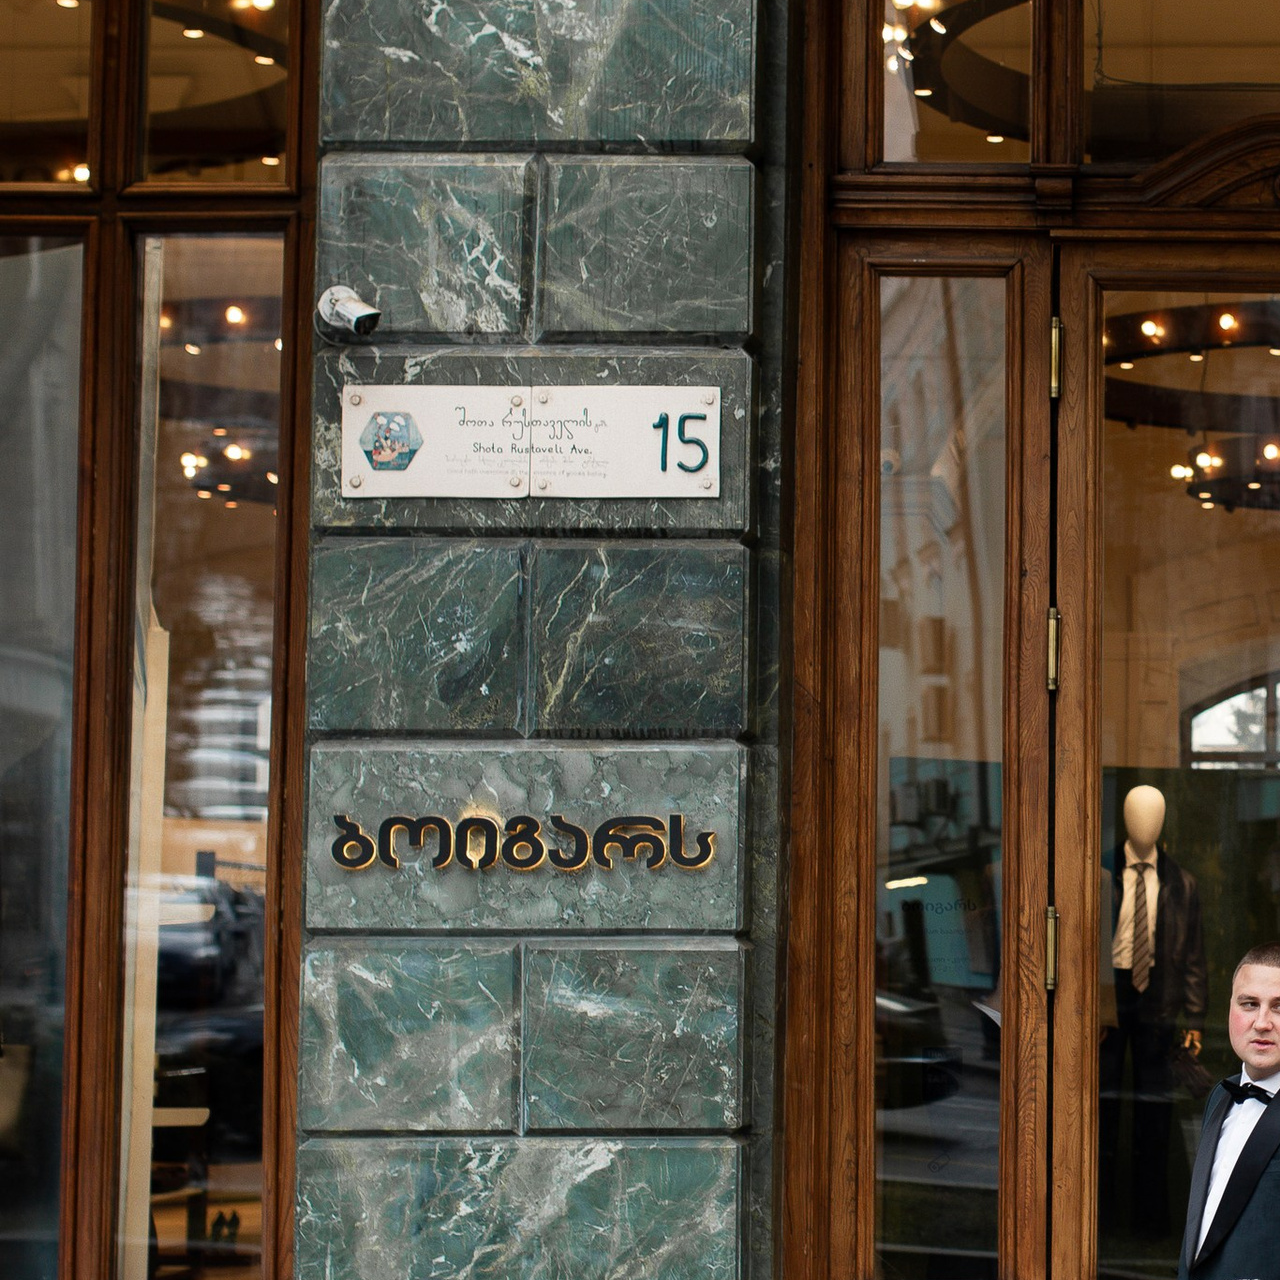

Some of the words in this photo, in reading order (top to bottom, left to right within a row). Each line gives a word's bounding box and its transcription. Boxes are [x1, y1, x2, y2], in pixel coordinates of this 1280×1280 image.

[455, 406, 495, 427] შოთა
[472, 442, 503, 454] Shota
[511, 443, 563, 455] Rustaveli
[570, 443, 593, 455] Ave.
[651, 411, 710, 473] 15
[331, 814, 717, 870] ბოიგარს
